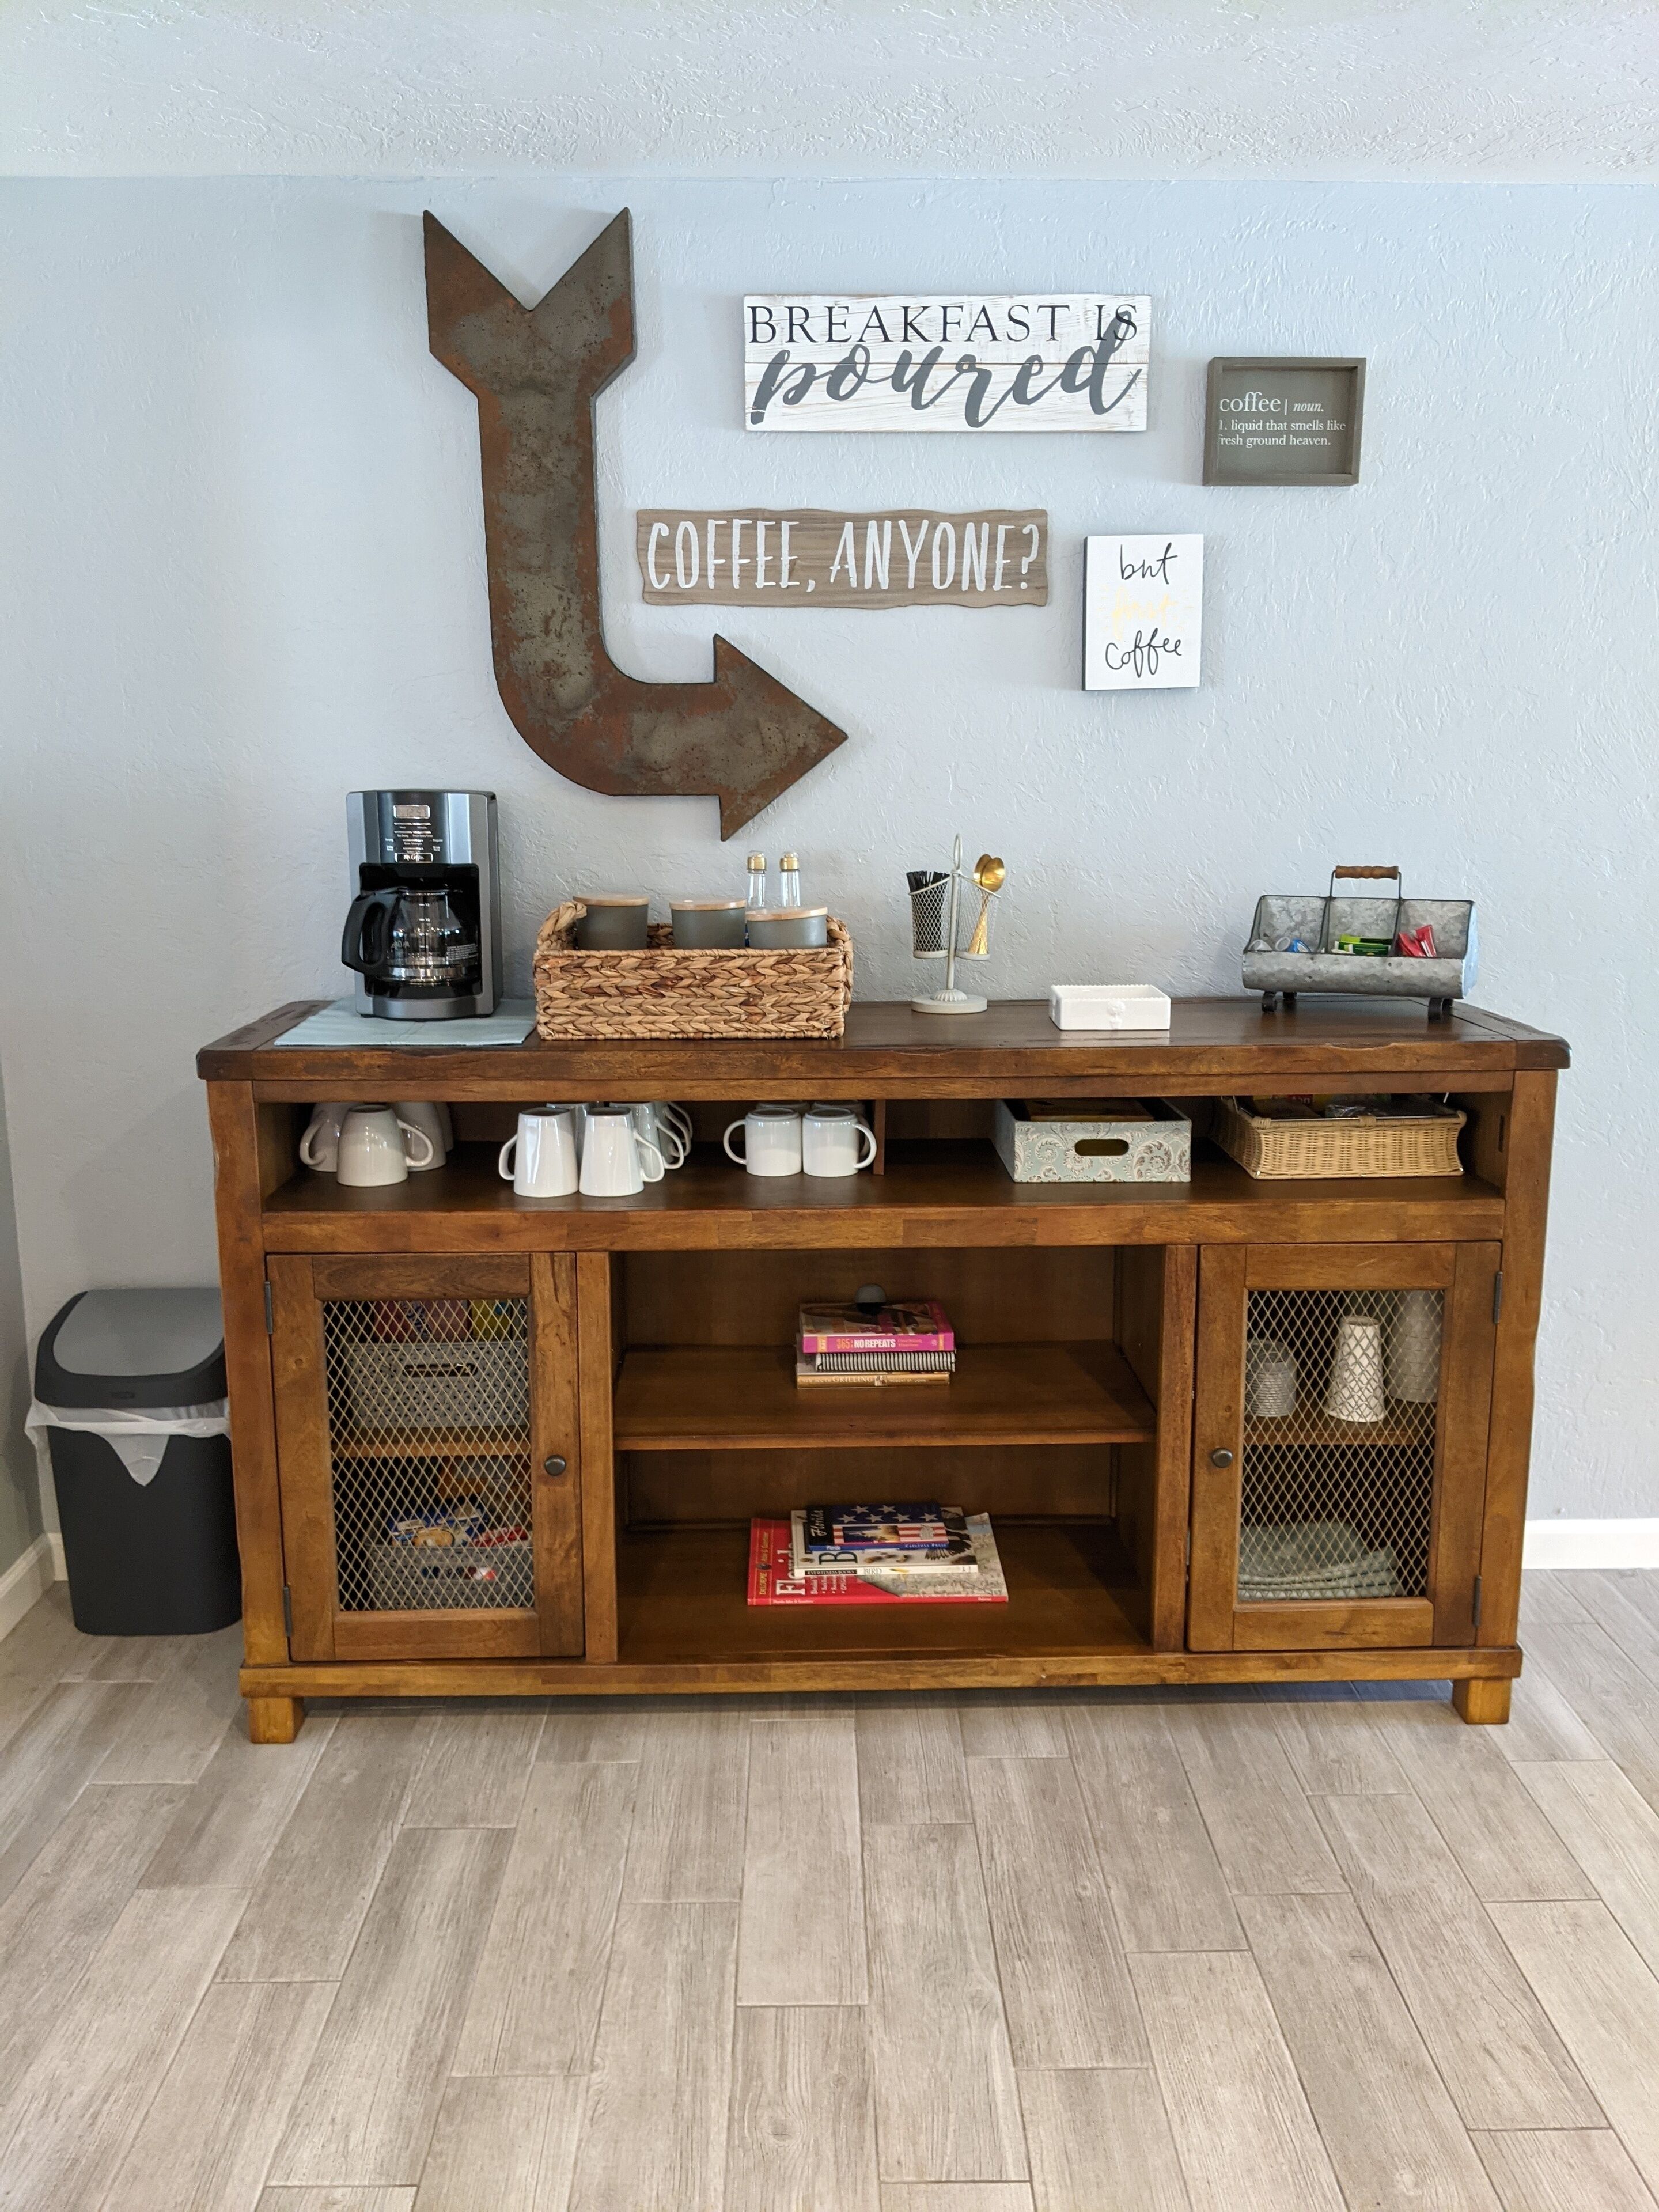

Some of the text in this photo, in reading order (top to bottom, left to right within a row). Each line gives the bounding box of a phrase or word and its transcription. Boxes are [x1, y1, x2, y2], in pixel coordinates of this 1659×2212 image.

[747, 304, 1138, 344] BREAKFAST IS
[749, 310, 1143, 428] poured
[1219, 392, 1324, 412] coffee noun.
[1231, 419, 1263, 433] liquid
[1266, 420, 1287, 430] that
[1290, 420, 1324, 430] smells
[1327, 420, 1346, 430] like
[1246, 434, 1286, 448] ground
[1290, 435, 1331, 445] heaven.
[648, 519, 1039, 593] COFFEE, ANYONE?
[854, 1339, 865, 1349] NO
[865, 1339, 896, 1348] REPEATS
[810, 1509, 827, 1537] Florida
